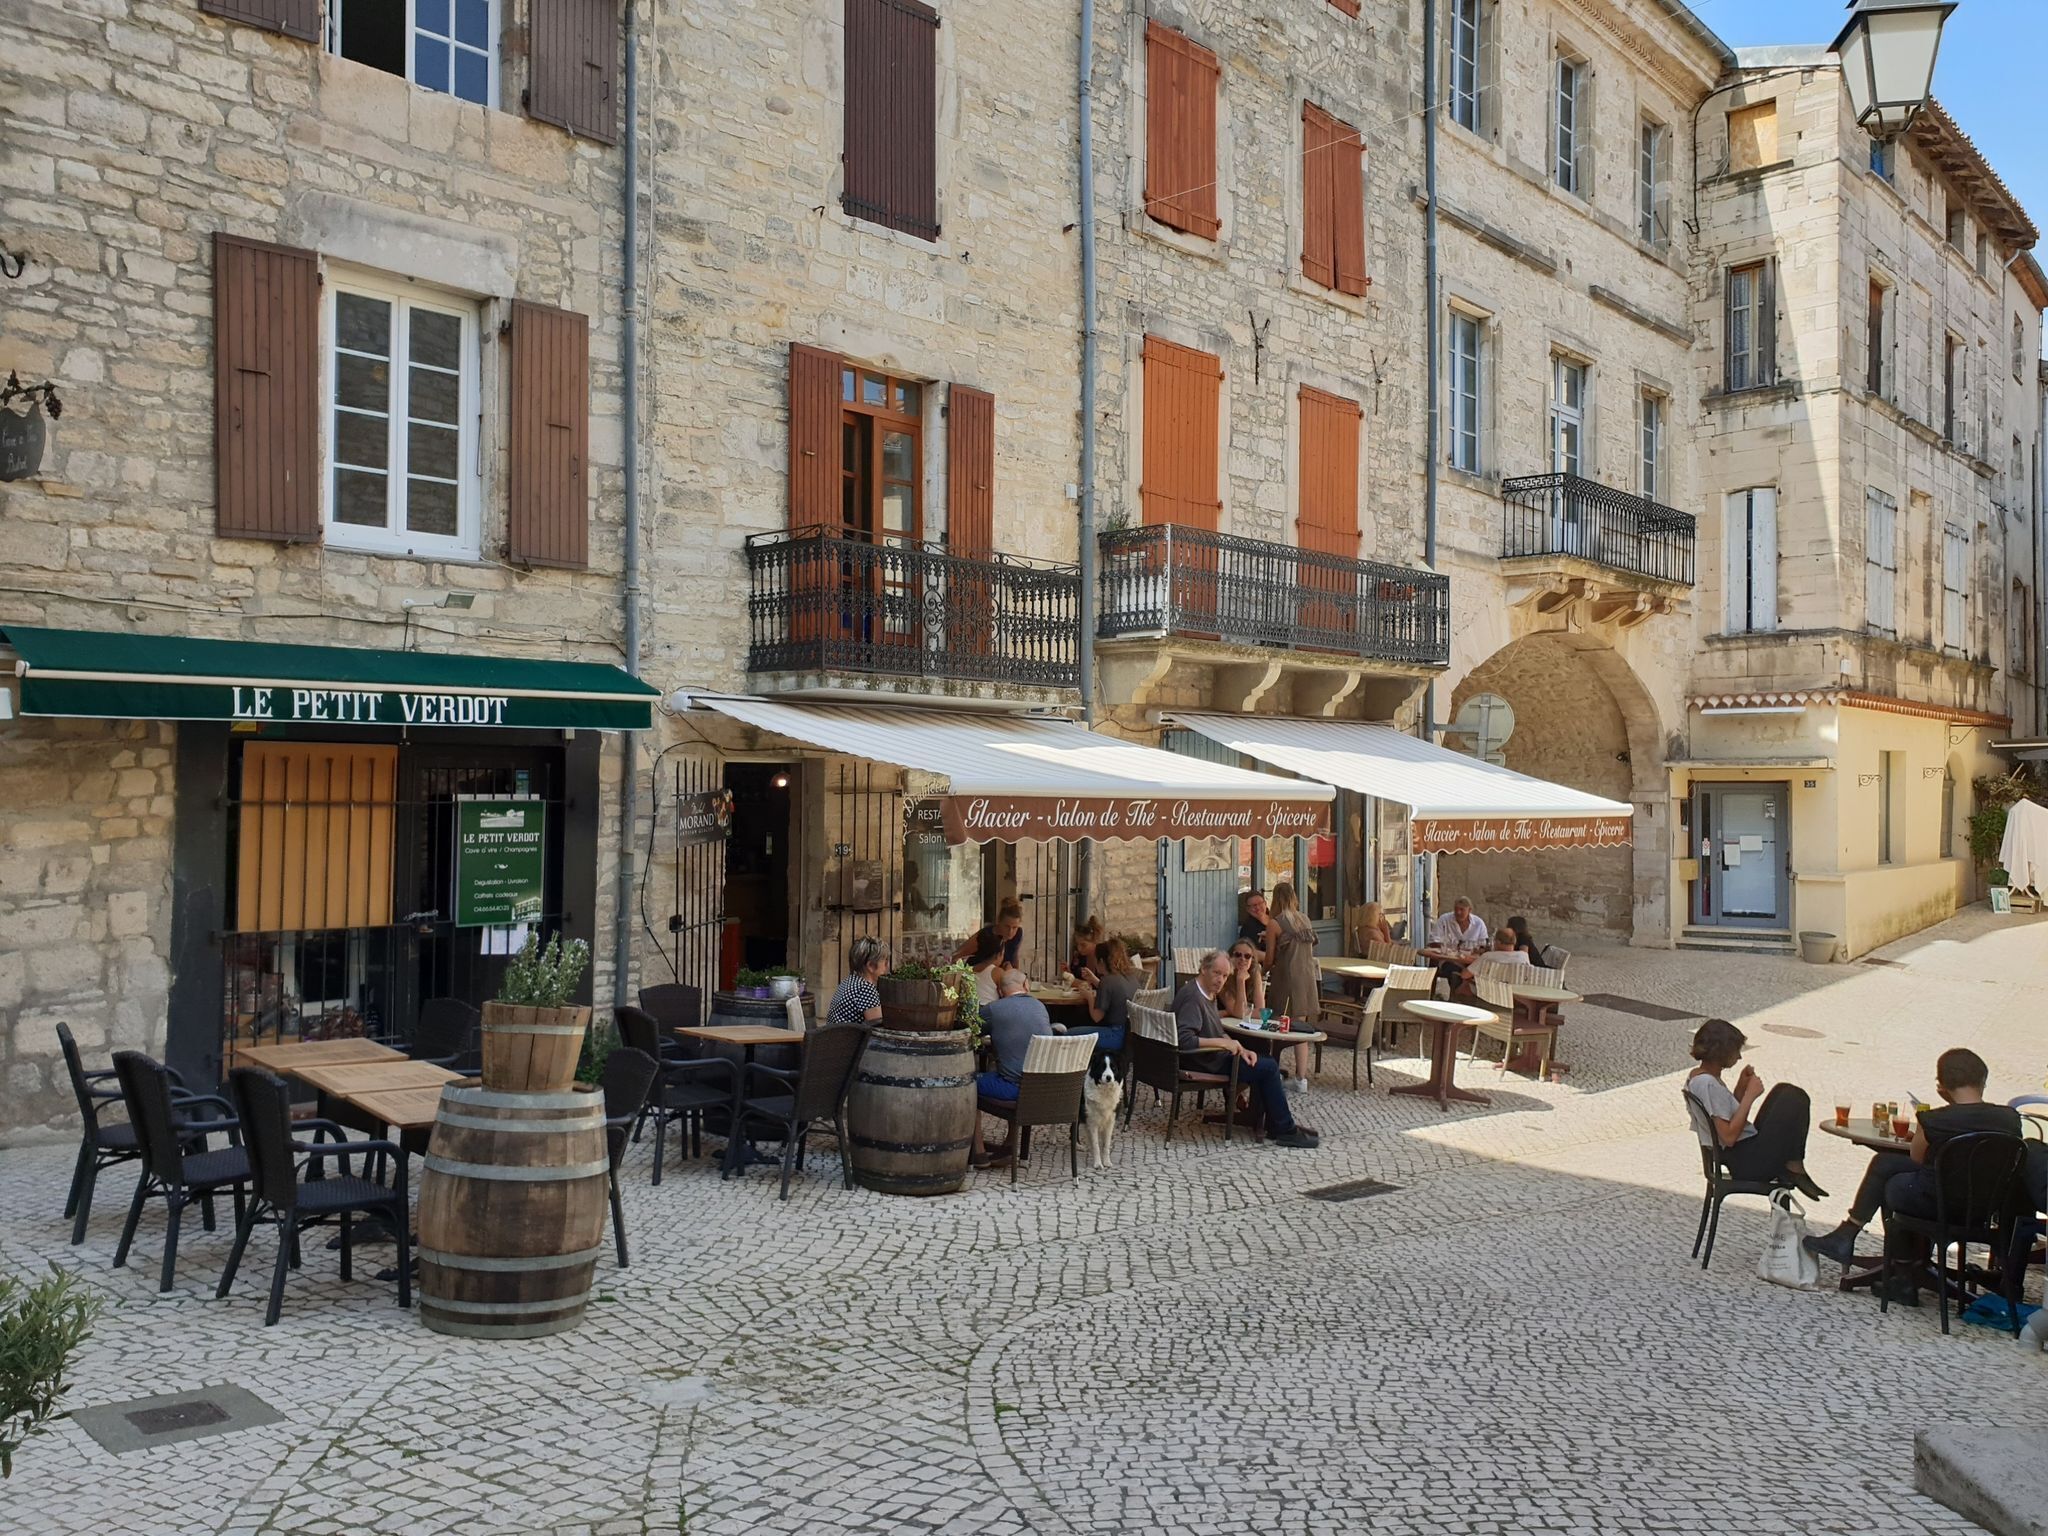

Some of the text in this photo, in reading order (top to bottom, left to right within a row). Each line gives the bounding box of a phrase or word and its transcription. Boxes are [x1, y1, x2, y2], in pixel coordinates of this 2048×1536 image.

[232, 686, 509, 724] LE PETIT VERDOT
[679, 813, 714, 830] MORAND
[964, 798, 1318, 835] Glacier Salon de Thé Restaurant Epicerie
[463, 832, 540, 843] LE PETIT VERDOT
[919, 833, 942, 844] Salon
[1423, 820, 1461, 842] Glacier
[1468, 820, 1496, 841] Salon
[1499, 820, 1510, 841] de
[1513, 819, 1531, 840] Thé
[1539, 819, 1588, 839] Restaurant
[837, 845, 849, 855] 19
